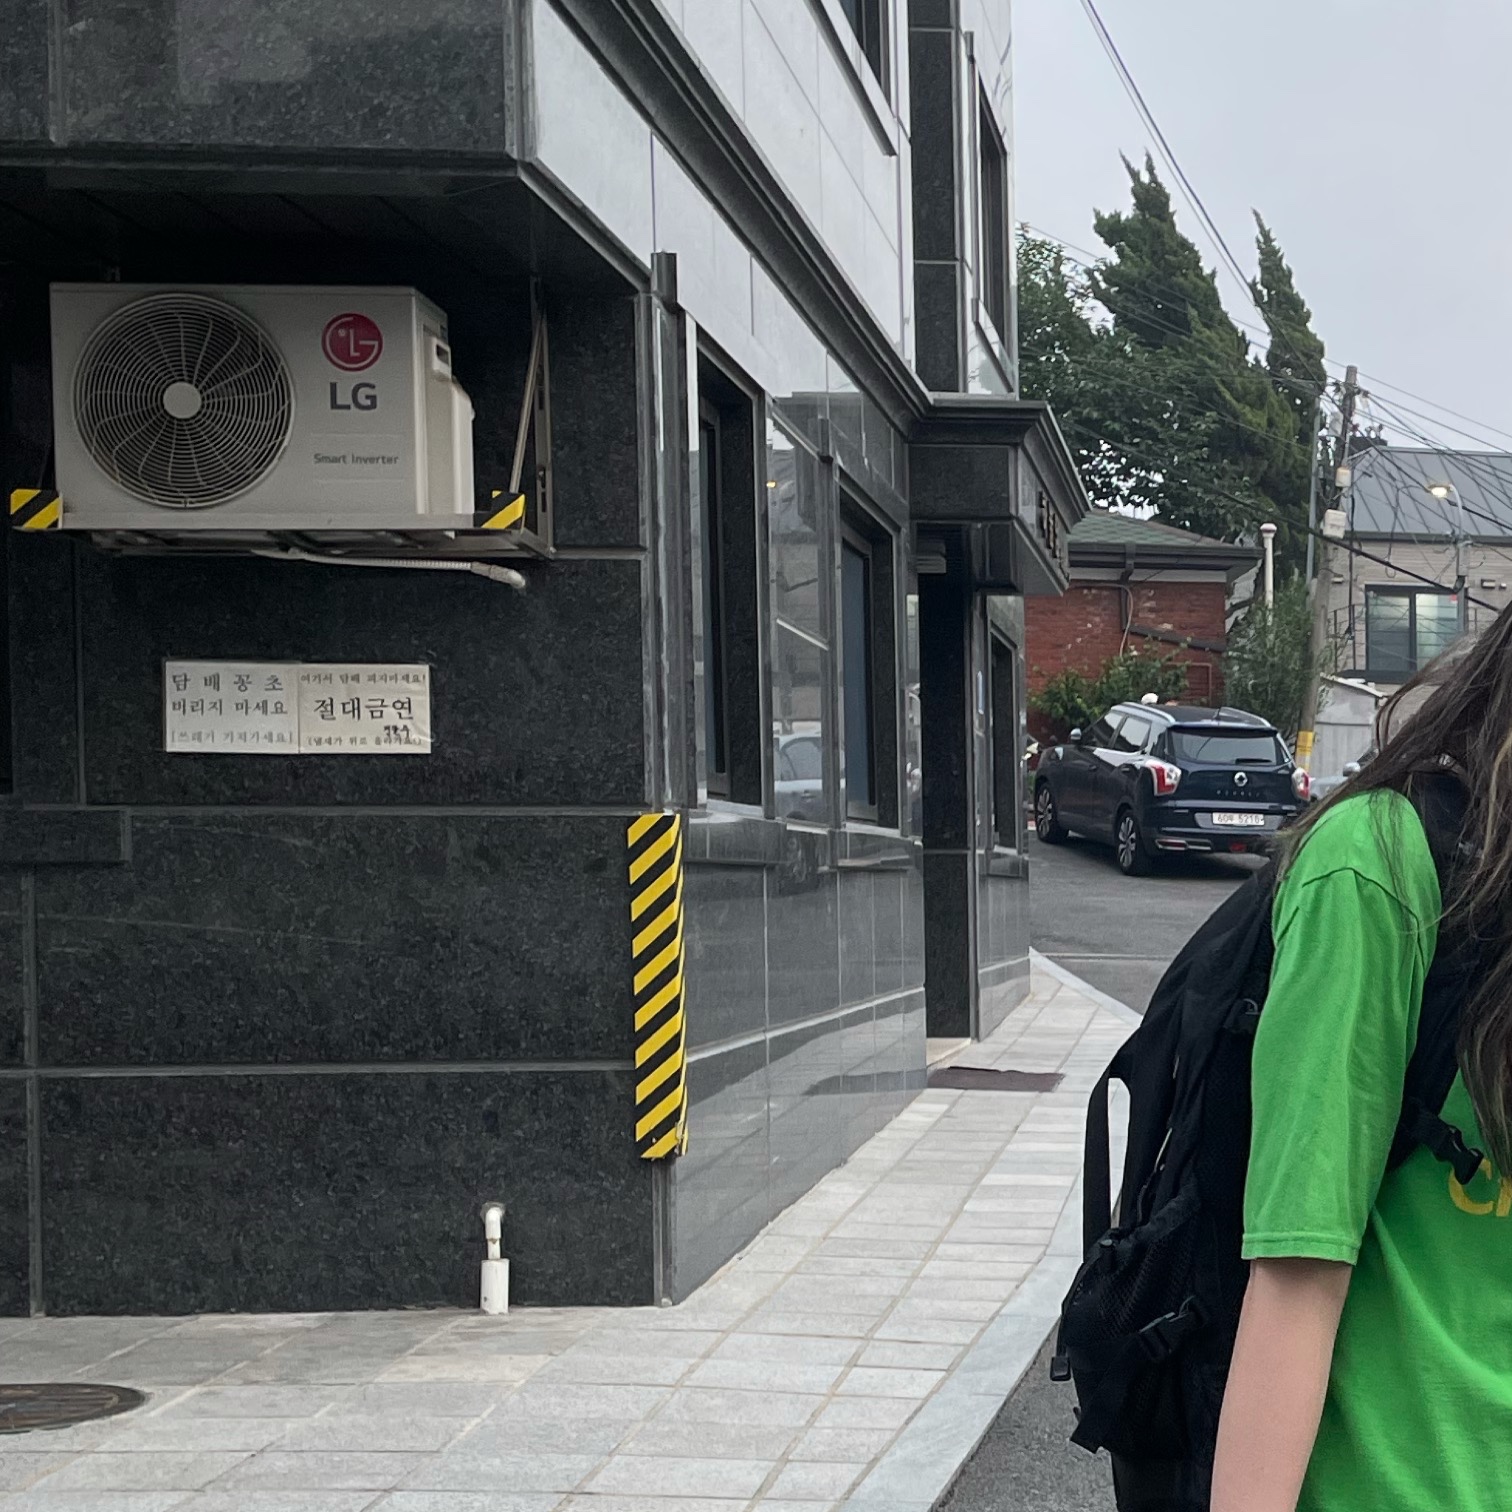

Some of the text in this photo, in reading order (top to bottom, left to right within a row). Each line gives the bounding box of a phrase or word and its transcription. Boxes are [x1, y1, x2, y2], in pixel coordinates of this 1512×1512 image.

[330, 382, 378, 411] LG
[314, 452, 399, 465] Smart Inverter
[339, 673, 361, 684] 담배
[172, 698, 288, 716] 버리지 마세요
[313, 696, 414, 721] 절대금연
